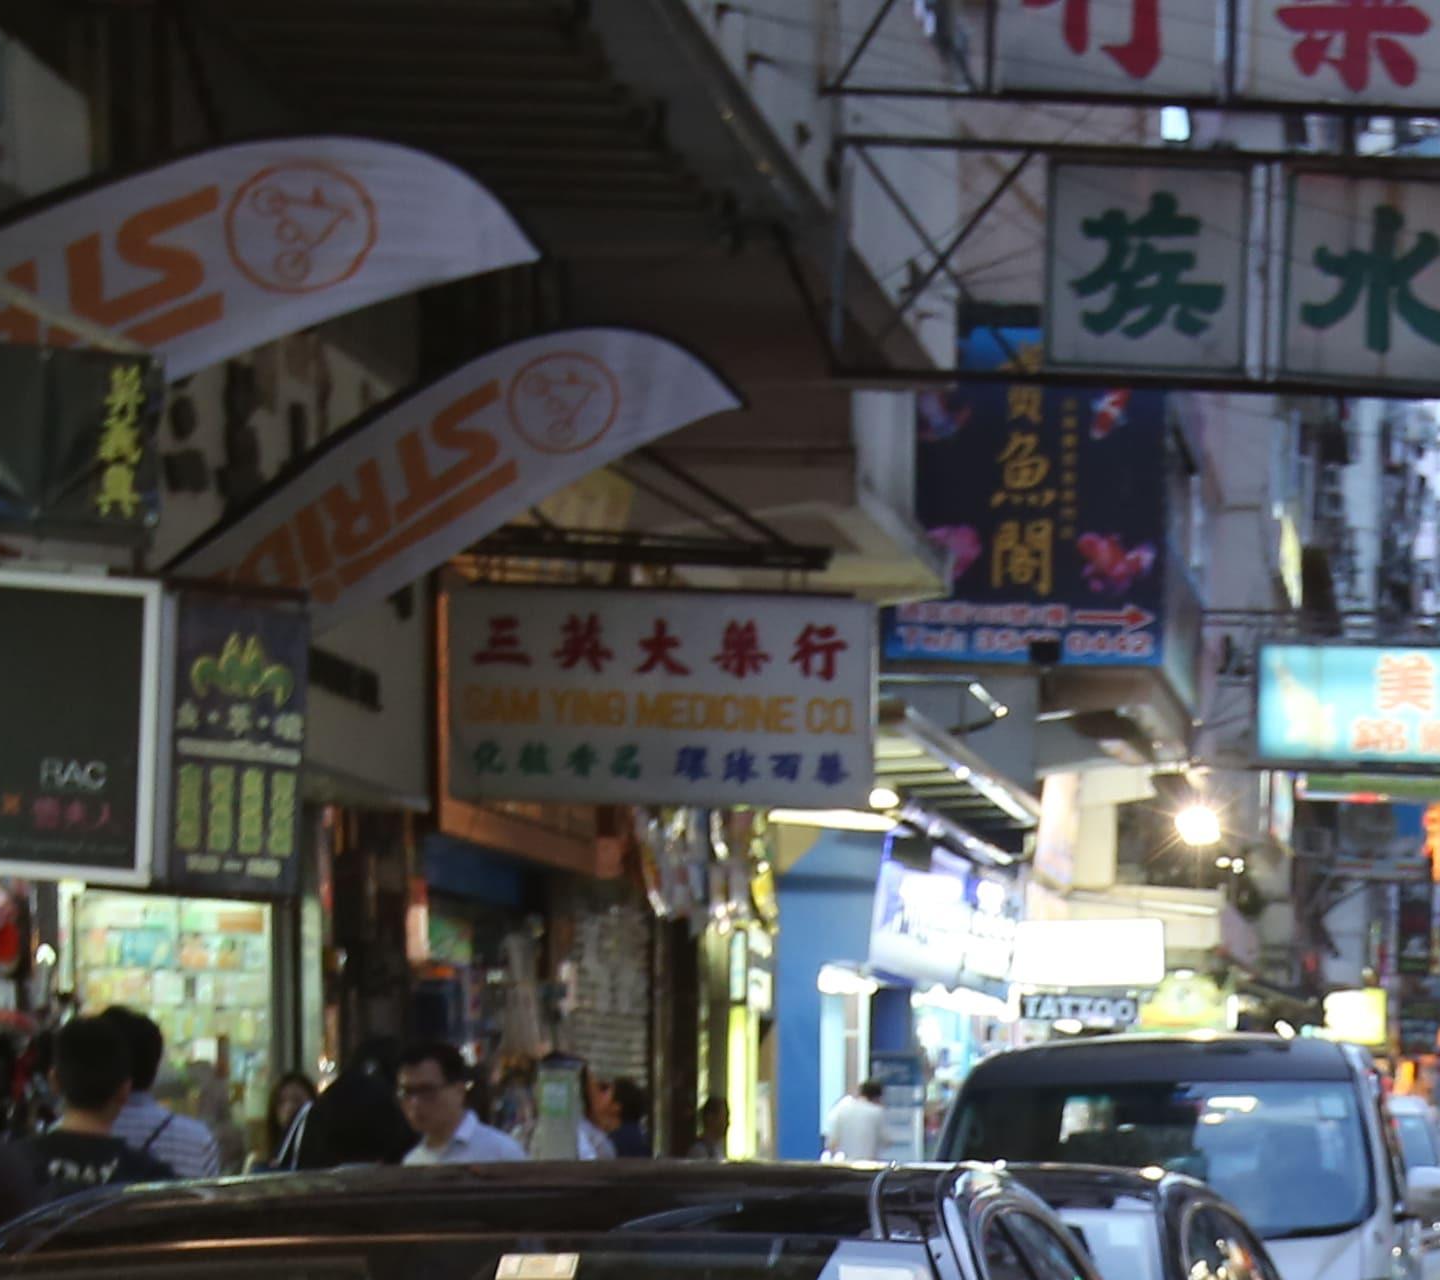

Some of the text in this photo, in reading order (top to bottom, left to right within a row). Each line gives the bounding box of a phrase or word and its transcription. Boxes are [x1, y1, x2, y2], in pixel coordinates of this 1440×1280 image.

[463, 686, 541, 726] SAM
[548, 688, 625, 727] YING
[634, 691, 796, 734] MEDICINE
[40, 759, 107, 791] RAC
[1023, 996, 1136, 1023] TATTOO
